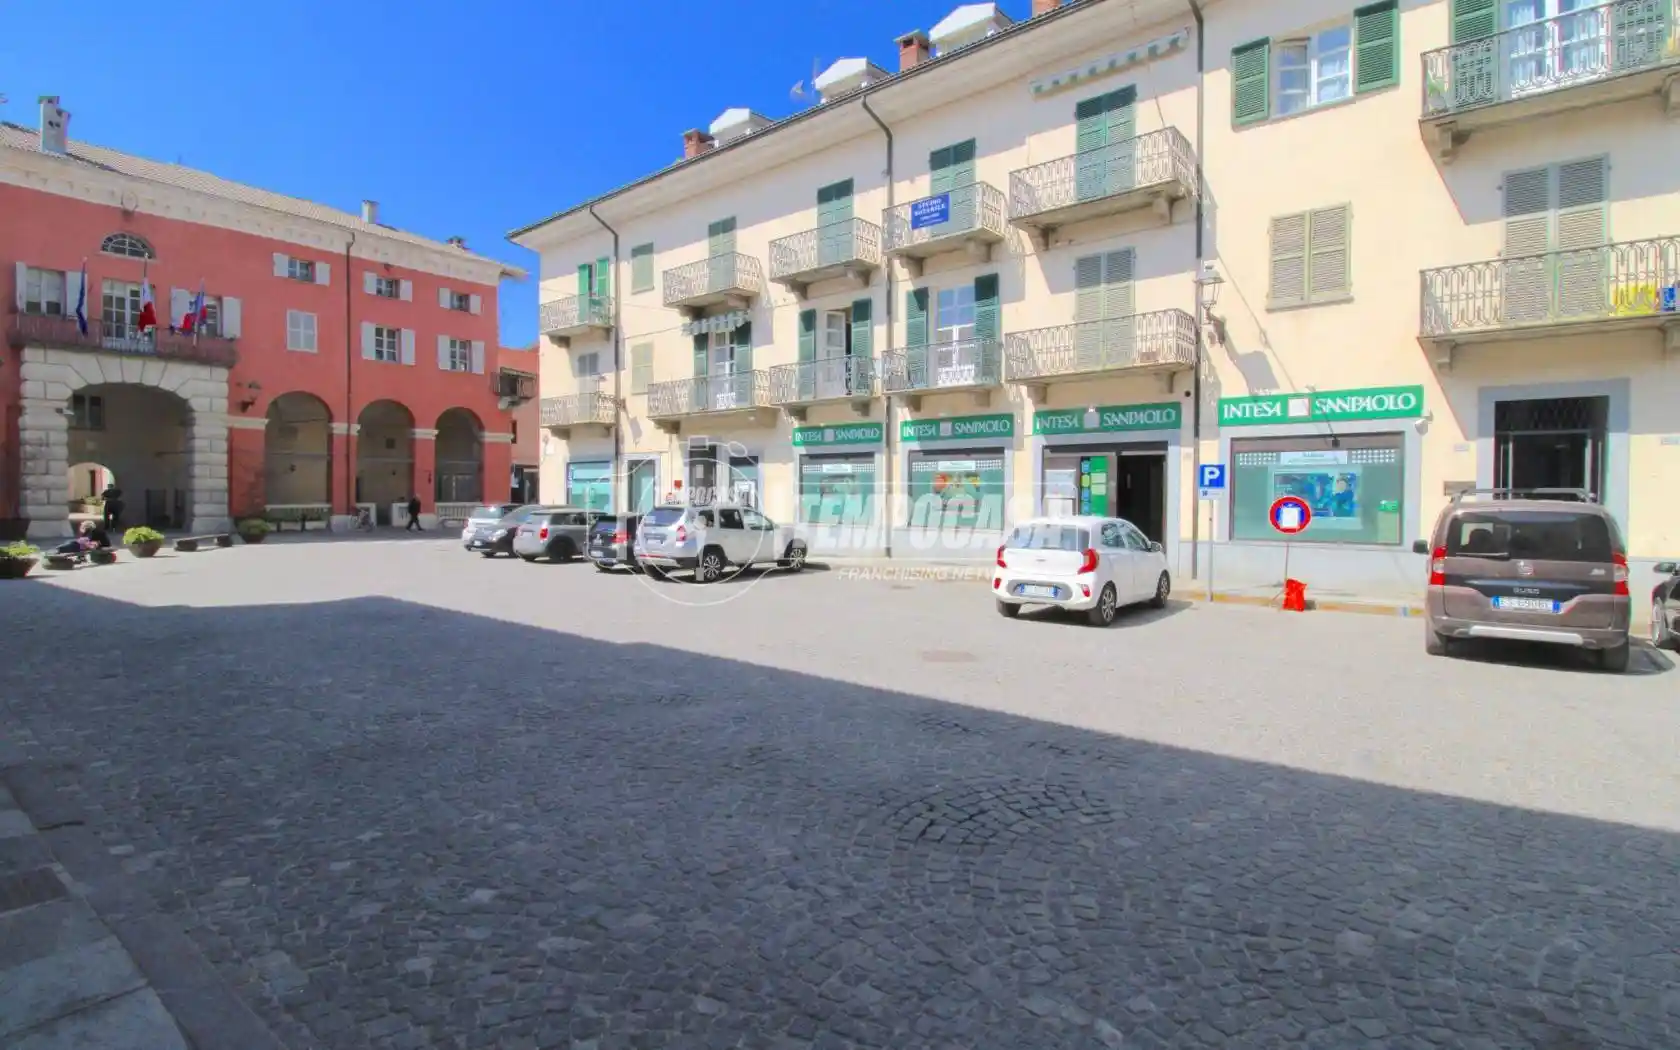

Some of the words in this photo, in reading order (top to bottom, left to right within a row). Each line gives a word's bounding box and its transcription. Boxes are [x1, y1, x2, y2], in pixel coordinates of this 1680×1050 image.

[1223, 401, 1281, 420] INTESA
[1314, 393, 1416, 415] SANPAOLO
[903, 423, 936, 437] INTESA
[954, 419, 1011, 434] SANPAOLO
[1035, 413, 1081, 430] INTESA
[1103, 408, 1176, 427] SANPAOLO
[795, 431, 822, 442] INTESA
[835, 427, 880, 441] SANPAOLO
[1203, 467, 1221, 486] P
